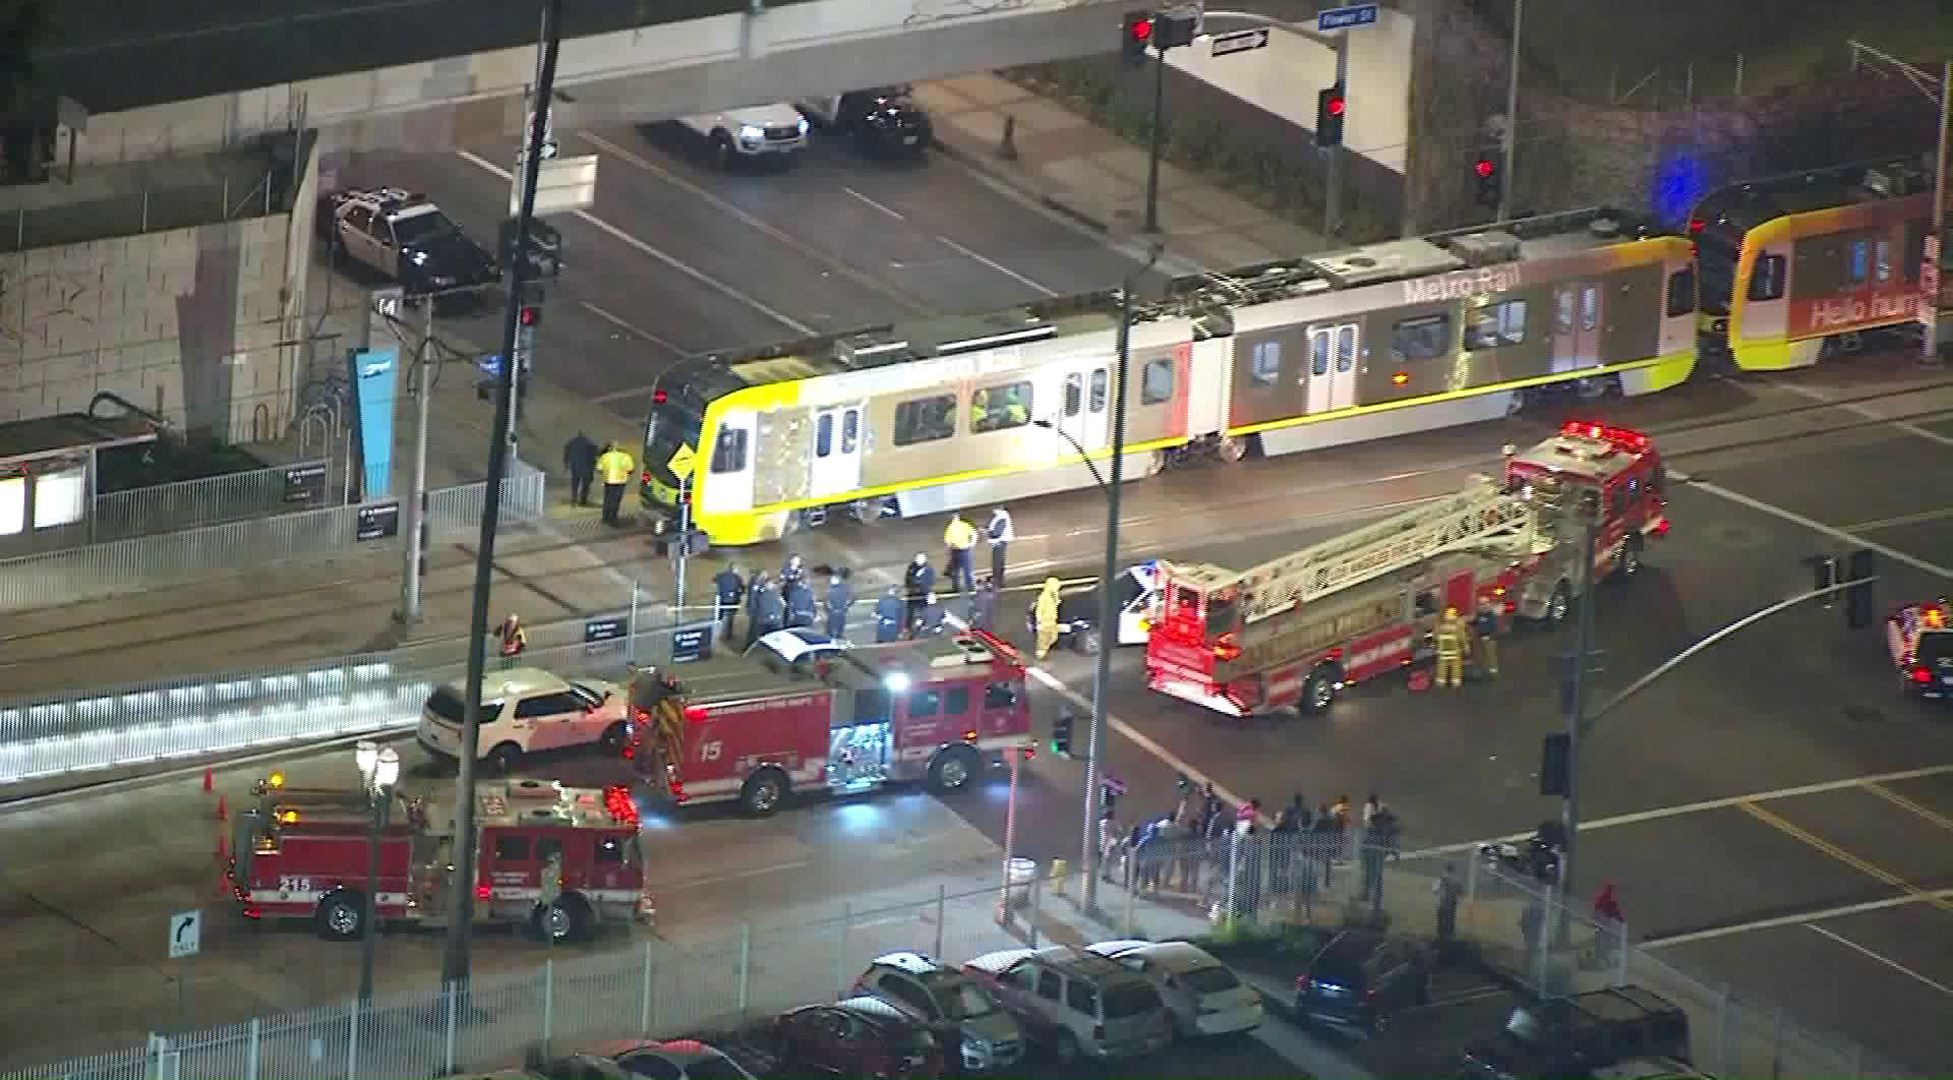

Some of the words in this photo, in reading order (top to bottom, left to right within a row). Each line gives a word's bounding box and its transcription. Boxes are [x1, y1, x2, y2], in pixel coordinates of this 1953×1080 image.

[1402, 276, 1474, 303] Metro
[1480, 262, 1520, 294] Rail
[1811, 297, 1867, 330] Hello
[1871, 291, 1923, 319] hum
[701, 740, 722, 763] 15
[279, 876, 310, 892] 215
